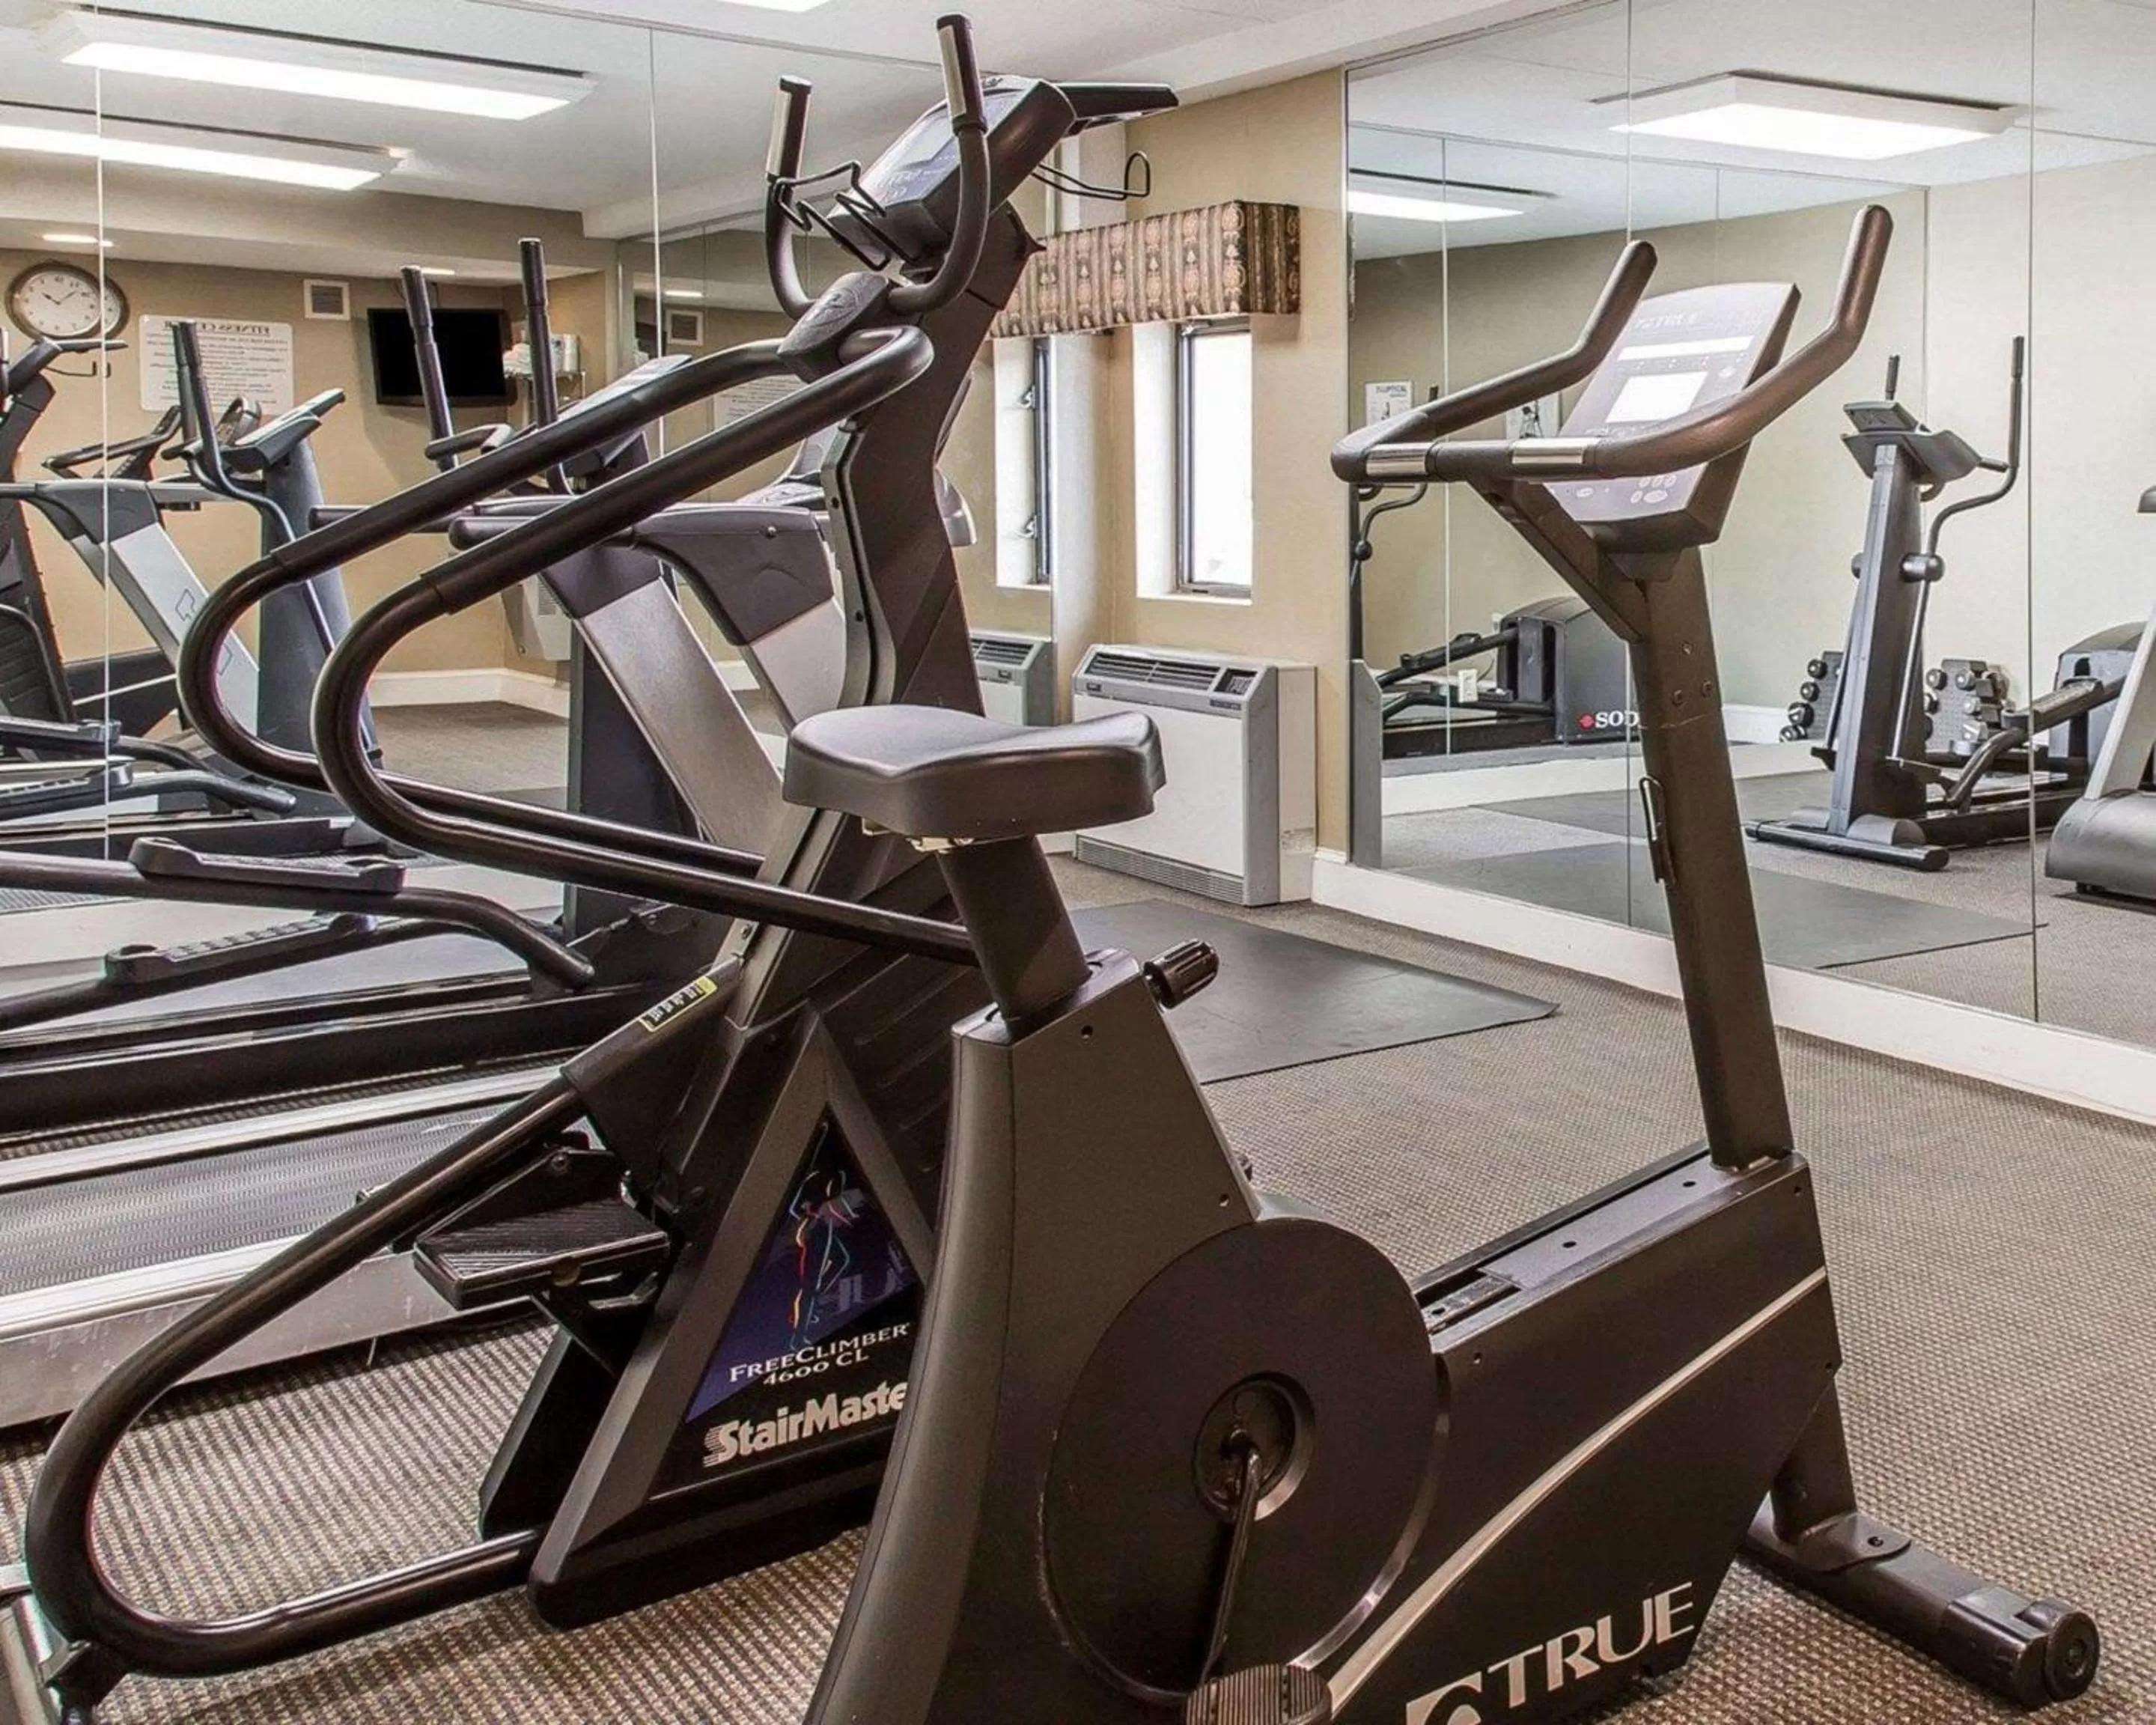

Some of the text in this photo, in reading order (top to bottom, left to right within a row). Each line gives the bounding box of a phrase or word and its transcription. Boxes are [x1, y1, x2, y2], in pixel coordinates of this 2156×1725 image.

[763, 1348, 868, 1385] 4600 CL
[703, 1381, 908, 1468] StairMaste
[1487, 1581, 1695, 1709] TRUE
